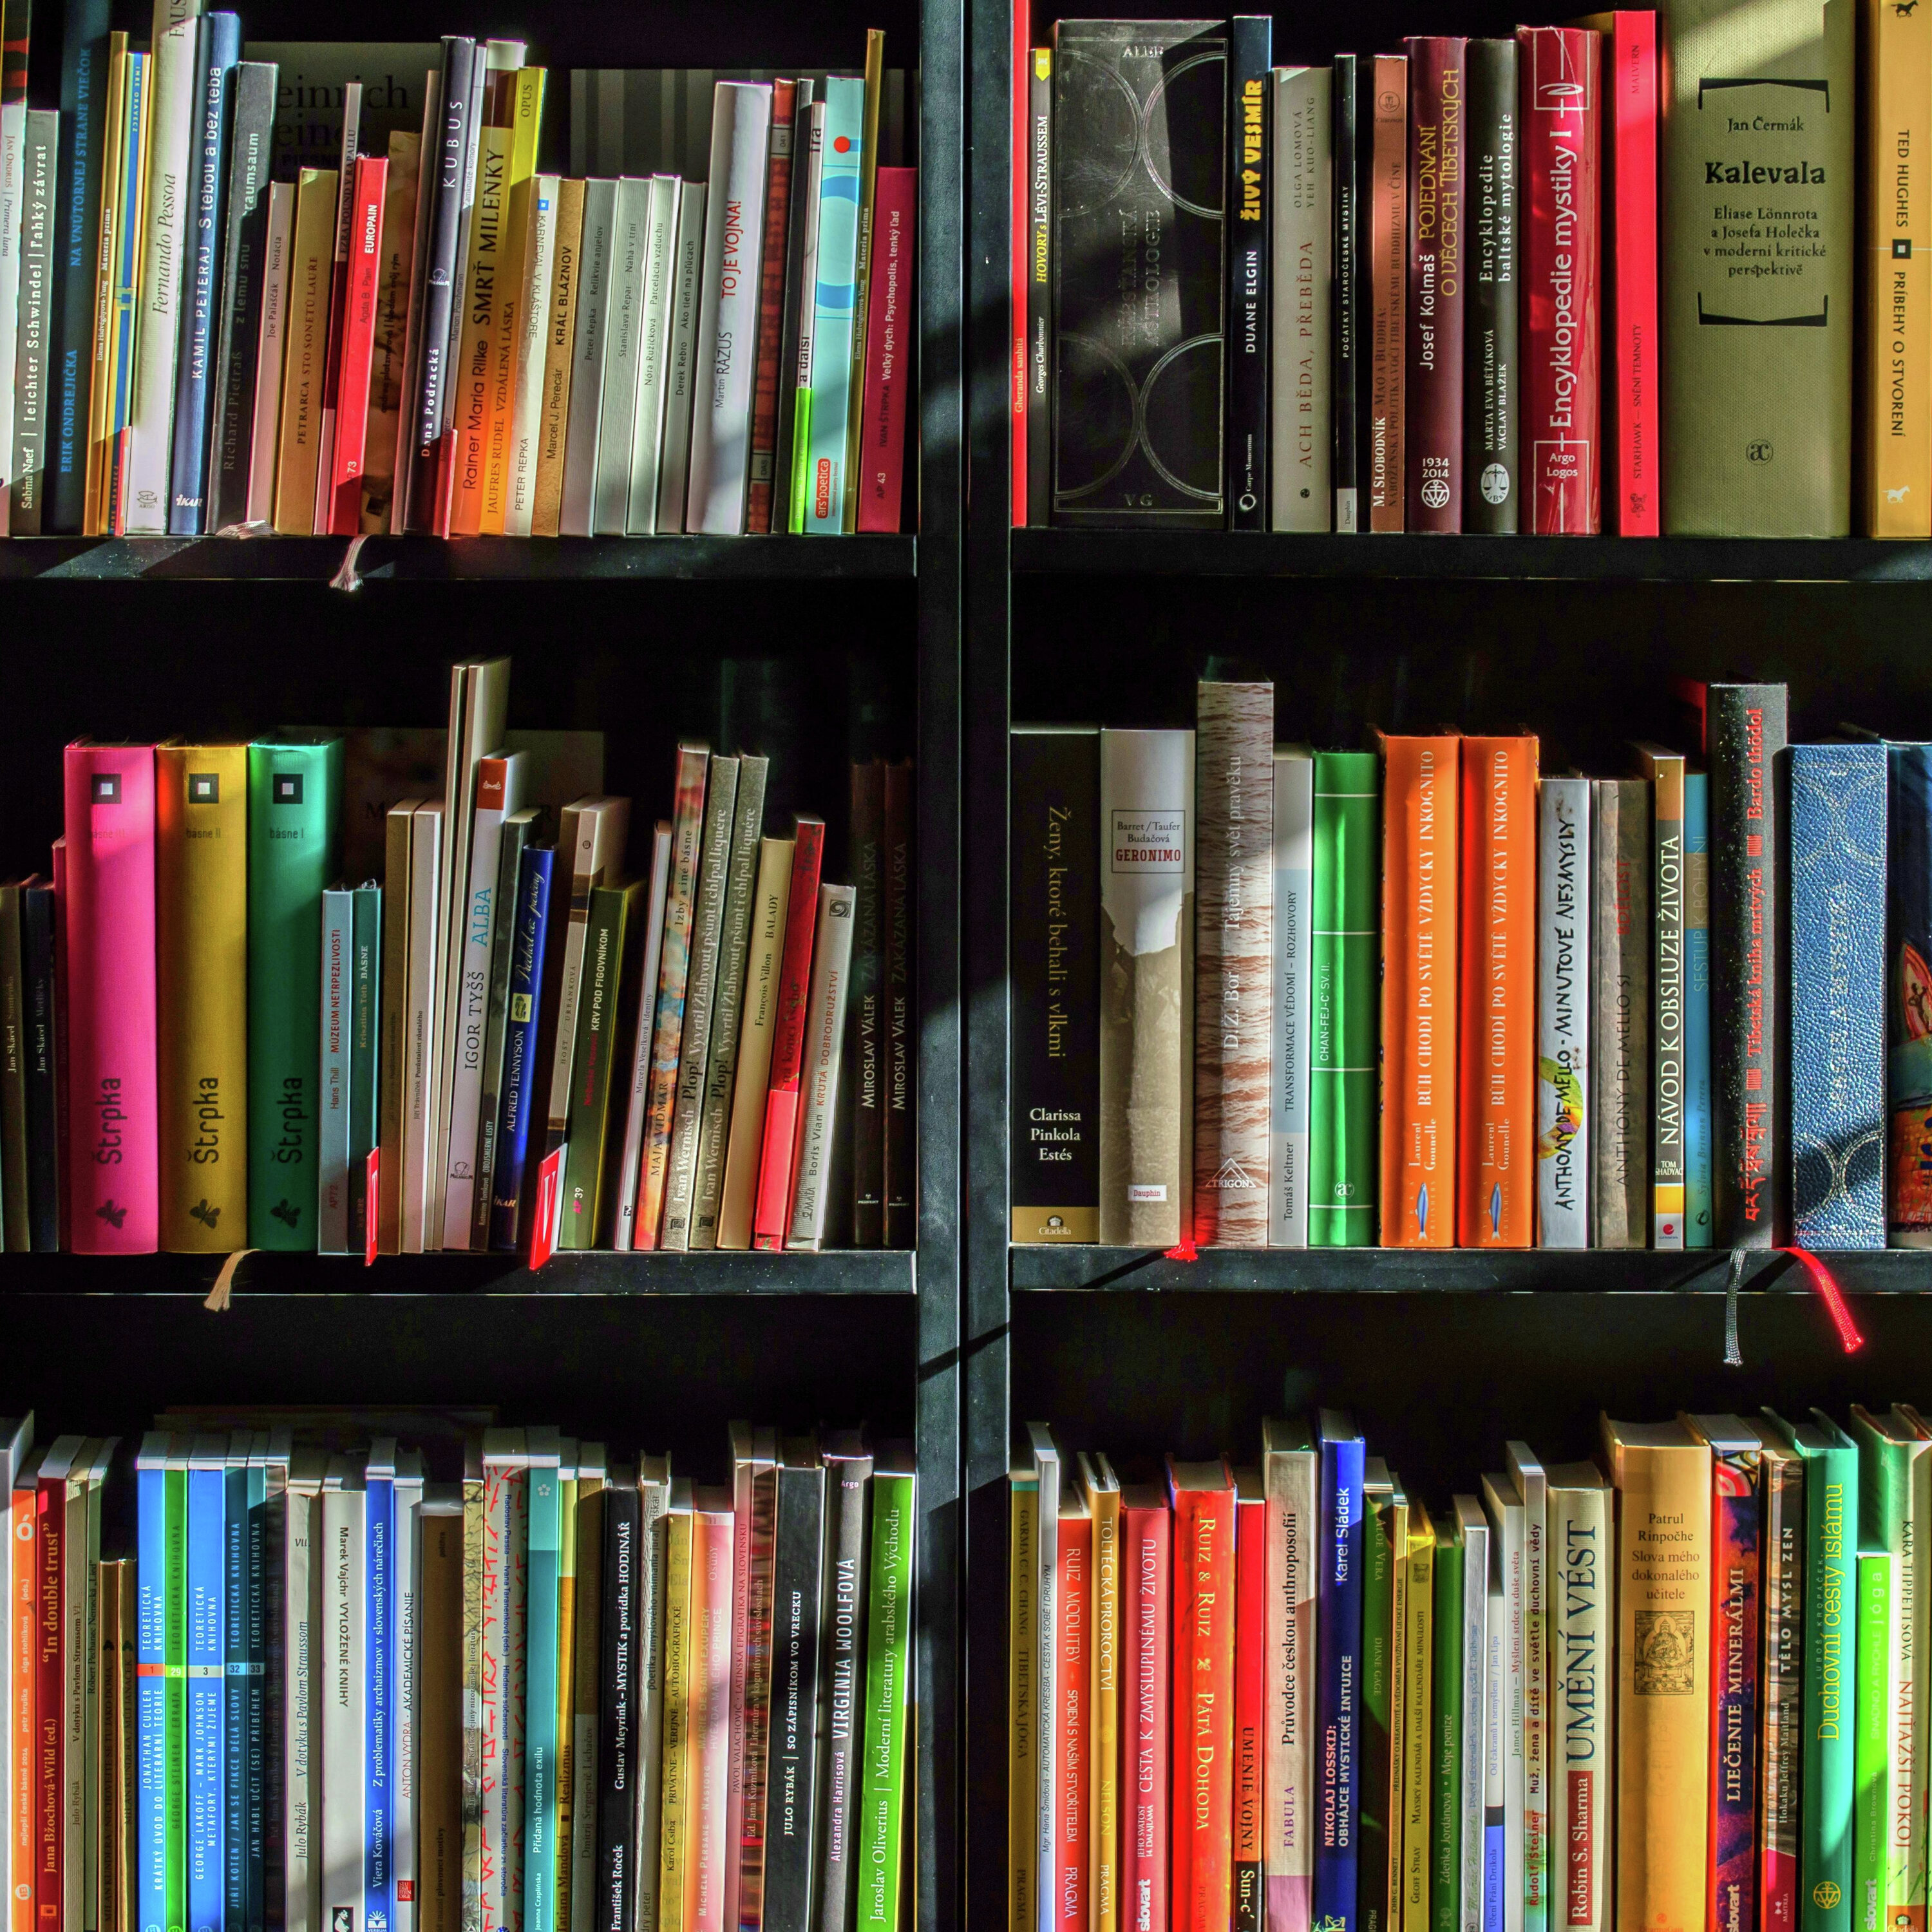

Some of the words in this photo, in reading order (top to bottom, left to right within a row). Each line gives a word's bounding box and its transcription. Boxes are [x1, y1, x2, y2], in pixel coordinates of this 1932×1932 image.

[206, 68, 222, 104] teba
[520, 84, 533, 117] OPUS
[203, 111, 220, 140] bez
[1242, 81, 1262, 162] VESMÍR
[1727, 118, 1748, 133] Jan
[1752, 115, 1804, 131] Čermák
[1897, 130, 1910, 158] TED
[32, 145, 47, 196] závrat
[205, 146, 217, 156] a
[1498, 114, 1515, 207] mytologie
[1705, 162, 1825, 184] Kalevala
[156, 174, 176, 227] Pessoa
[199, 162, 216, 212] tebou
[481, 149, 504, 252] MILENKY
[1241, 170, 1261, 221] ŽIVÝ
[1551, 147, 1574, 246] mystiky
[1896, 164, 1909, 228] HUGHES
[198, 217, 212, 228] S
[364, 204, 378, 254] EUROPAIN
[724, 200, 742, 254] VOJNA!
[1479, 155, 1497, 281] Encyklopedie
[1711, 229, 1718, 238] a
[1722, 226, 1761, 240] Josefa
[1766, 226, 1819, 239] Holečka
[1714, 207, 1752, 220] Eliase
[1757, 207, 1817, 220] Lönnrota
[654, 223, 663, 258] vzduchu
[1497, 216, 1512, 281] baltské
[1715, 244, 1771, 257] moderní
[1776, 244, 1826, 257] kritické
[152, 232, 174, 314] Fernando
[195, 245, 211, 317] PETERAJ
[650, 261, 661, 305] Parcelácia
[721, 277, 737, 298] TO
[723, 259, 741, 273] JE
[1245, 251, 1257, 295] ELGIN
[1418, 254, 1435, 316] Kolmaš
[1728, 263, 1803, 278] perspektivě
[26, 263, 43, 348] Schwindel
[471, 261, 495, 325] SMRŤ
[1892, 271, 1906, 334] PRÍBEHY
[1245, 303, 1256, 352] DUANE
[1419, 324, 1435, 370] Josef
[1550, 254, 1572, 428] Encyklopedie
[1893, 341, 1904, 352] O
[191, 327, 207, 378] KAMIL
[469, 341, 488, 377] Rilke
[645, 365, 655, 385] Nóra
[715, 332, 732, 374] RÁZUS
[24, 357, 40, 422] leichter
[466, 383, 485, 430] Maria
[715, 379, 726, 408] Martin
[1891, 358, 1905, 436] STVORENÍ
[22, 448, 35, 472] Naef
[462, 436, 481, 489] Rainer
[517, 439, 529, 472] REPKA
[1423, 458, 1449, 468] 1934
[1423, 469, 1449, 478] 2014
[515, 477, 527, 510] PETER
[1421, 752, 1435, 840] INKOGNITO
[1115, 849, 1181, 862] GERONIMO
[1658, 835, 1680, 922] ŽIVOTA
[1416, 849, 1435, 925] VŽDYCKY
[472, 887, 492, 946] ALBA
[764, 895, 778, 938] BALADY
[593, 929, 609, 987] FIGOVNÍKOM
[759, 954, 773, 981] Villon
[1321, 963, 1331, 971] II.
[1416, 932, 1434, 980] SVĚTĚ
[1661, 928, 1680, 1029] OBSLUZE
[467, 972, 484, 1018] TYŠŠ
[592, 990, 603, 1009] POD
[755, 985, 772, 1027] François
[1320, 974, 1331, 989] SV.
[1419, 987, 1433, 1007] PO
[591, 1012, 601, 1030] KRV
[818, 971, 839, 1066] DOBRODRUŽSTVÍ
[860, 996, 876, 1036] VÁLEK
[464, 1024, 482, 1070] IGOR
[1416, 1015, 1434, 1067] CHODÍ
[1662, 1033, 1680, 1052] K
[815, 1070, 829, 1106] KRUTÁ
[861, 1040, 876, 1108] MIROSLAV
[1416, 1074, 1432, 1105] BŮH
[91, 1077, 127, 1165] Štrpka
[187, 1077, 224, 1164] Štrpka
[271, 1077, 308, 1164] Štrpka
[1030, 1108, 1081, 1122] Clarissa
[1658, 1057, 1680, 1144] NÁVOD
[811, 1114, 823, 1140] Vian
[1030, 1128, 1081, 1141] Pinkola
[808, 1144, 821, 1176] Boris
[1039, 1147, 1072, 1161] Estés
[1284, 1142, 1294, 1186] Keltner
[1133, 1189, 1161, 1198] Dauphin
[1283, 1189, 1293, 1220] Tomáš
[1039, 1226, 1071, 1235] Citadella
[1334, 1488, 1350, 1539] Sládek
[1638, 1531, 1694, 1541] Rinpočhe
[1649, 1513, 1684, 1524] Patrul
[1822, 1484, 1844, 1559] islámu
[883, 1510, 902, 1570] Východu
[1280, 1513, 1297, 1615] anthroposofií
[1335, 1544, 1349, 1582] Karel
[1066, 1548, 1081, 1582] RUIZ
[1139, 1539, 1157, 1595] ŽIVOTU
[1560, 1520, 1596, 1620] VÉST
[43, 1577, 59, 1632] double
[833, 1558, 855, 1650] WOOLFOVÁ
[881, 1577, 898, 1644] arabského
[1823, 1565, 1846, 1627] cesty
[1066, 1592, 1081, 1664] MODLITBY
[1280, 1619, 1296, 1671] českou
[1728, 1569, 1745, 1694] MINERÁLMI
[876, 1650, 896, 1712] literatury
[1137, 1603, 1155, 1723] ZMYSLUPLNÉMU
[1818, 1634, 1841, 1740] Duchovní
[142, 1690, 152, 1728] CULLER
[832, 1659, 851, 1738] VIRGINIA
[1281, 1675, 1296, 1745] Průvodce
[1558, 1632, 1596, 1762] UMĚNÍ
[43, 1719, 58, 1745] (ed.)
[875, 1718, 893, 1777] Moderní
[1140, 1730, 1154, 1739] K
[1723, 1705, 1743, 1801] LIEČENIE
[142, 1733, 152, 1789] JONATHAN
[532, 1747, 544, 1770] exilu
[832, 1752, 846, 1803] Harrisová
[1139, 1748, 1154, 1792] CESTA
[41, 1748, 58, 1841] Bžochová-Wild
[532, 1774, 544, 1814] hodnota
[1573, 1777, 1589, 1841] Sharma
[531, 1817, 545, 1852] Přidaná
[830, 1807, 843, 1861] Alexandra
[871, 1801, 889, 1862] Oliverius
[1573, 1848, 1589, 1862] S.
[43, 1844, 57, 1873] Jana
[869, 1867, 888, 1922] Jaroslav
[1138, 1879, 1150, 1931] slovart
[1573, 1868, 1589, 1918] Robin
